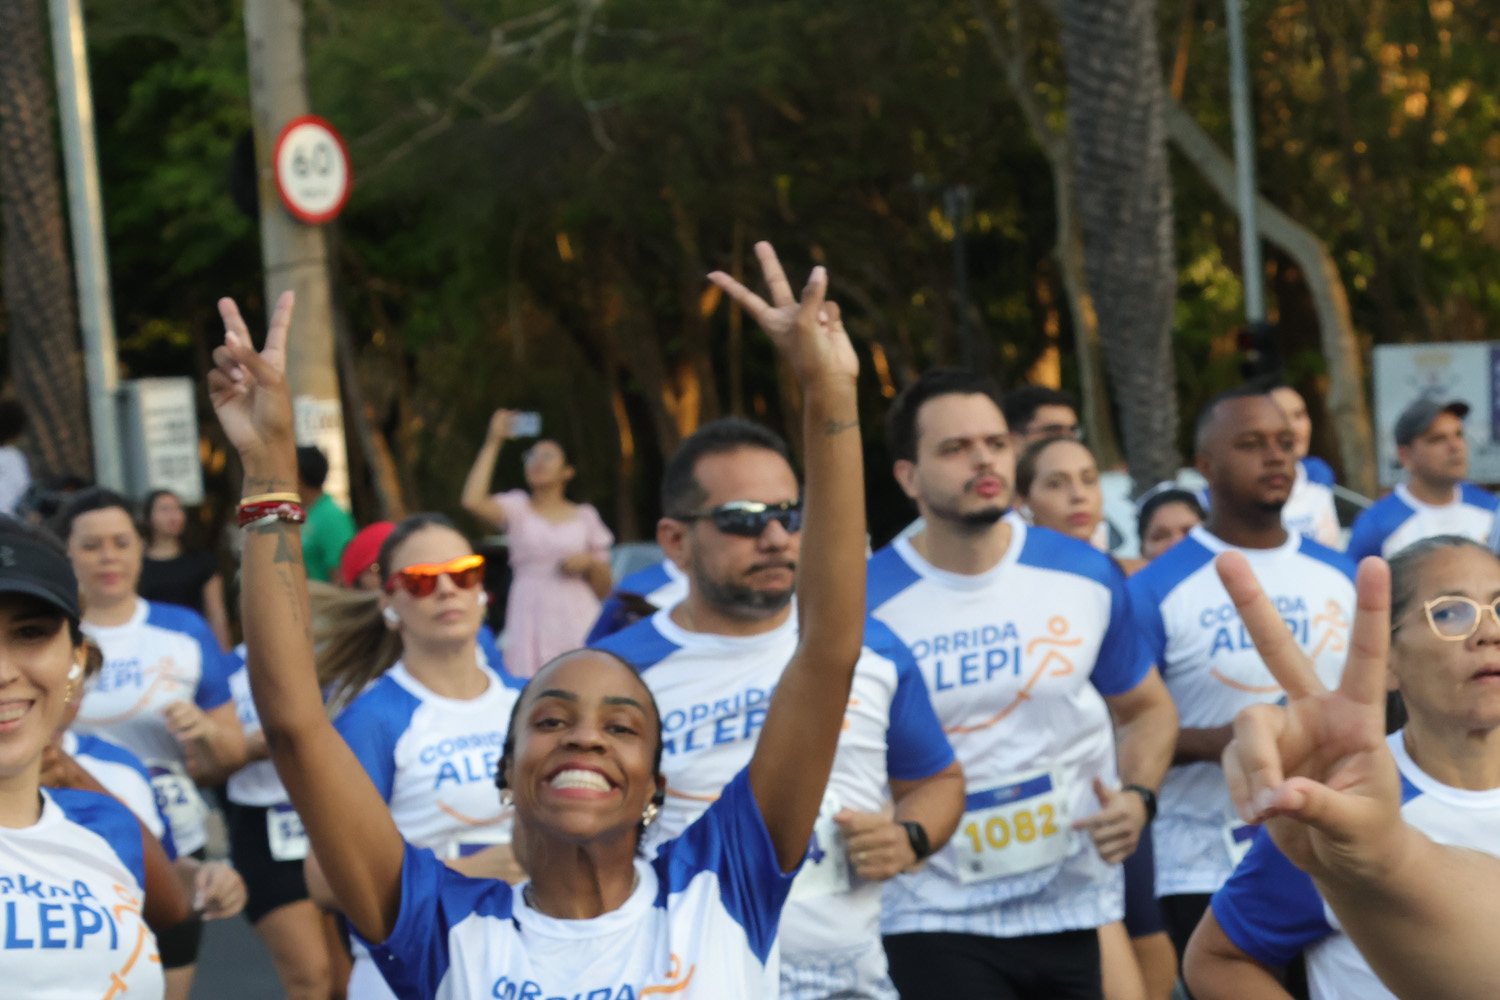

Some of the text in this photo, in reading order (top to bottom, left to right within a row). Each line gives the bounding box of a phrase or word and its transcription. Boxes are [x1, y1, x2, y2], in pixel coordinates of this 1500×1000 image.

[292, 143, 335, 178] 60
[911, 622, 1019, 660] ORRIDA
[935, 645, 1021, 692] LEPI
[434, 752, 500, 789] ALE
[965, 804, 1058, 854] 1082
[5, 901, 118, 950] LEPI
